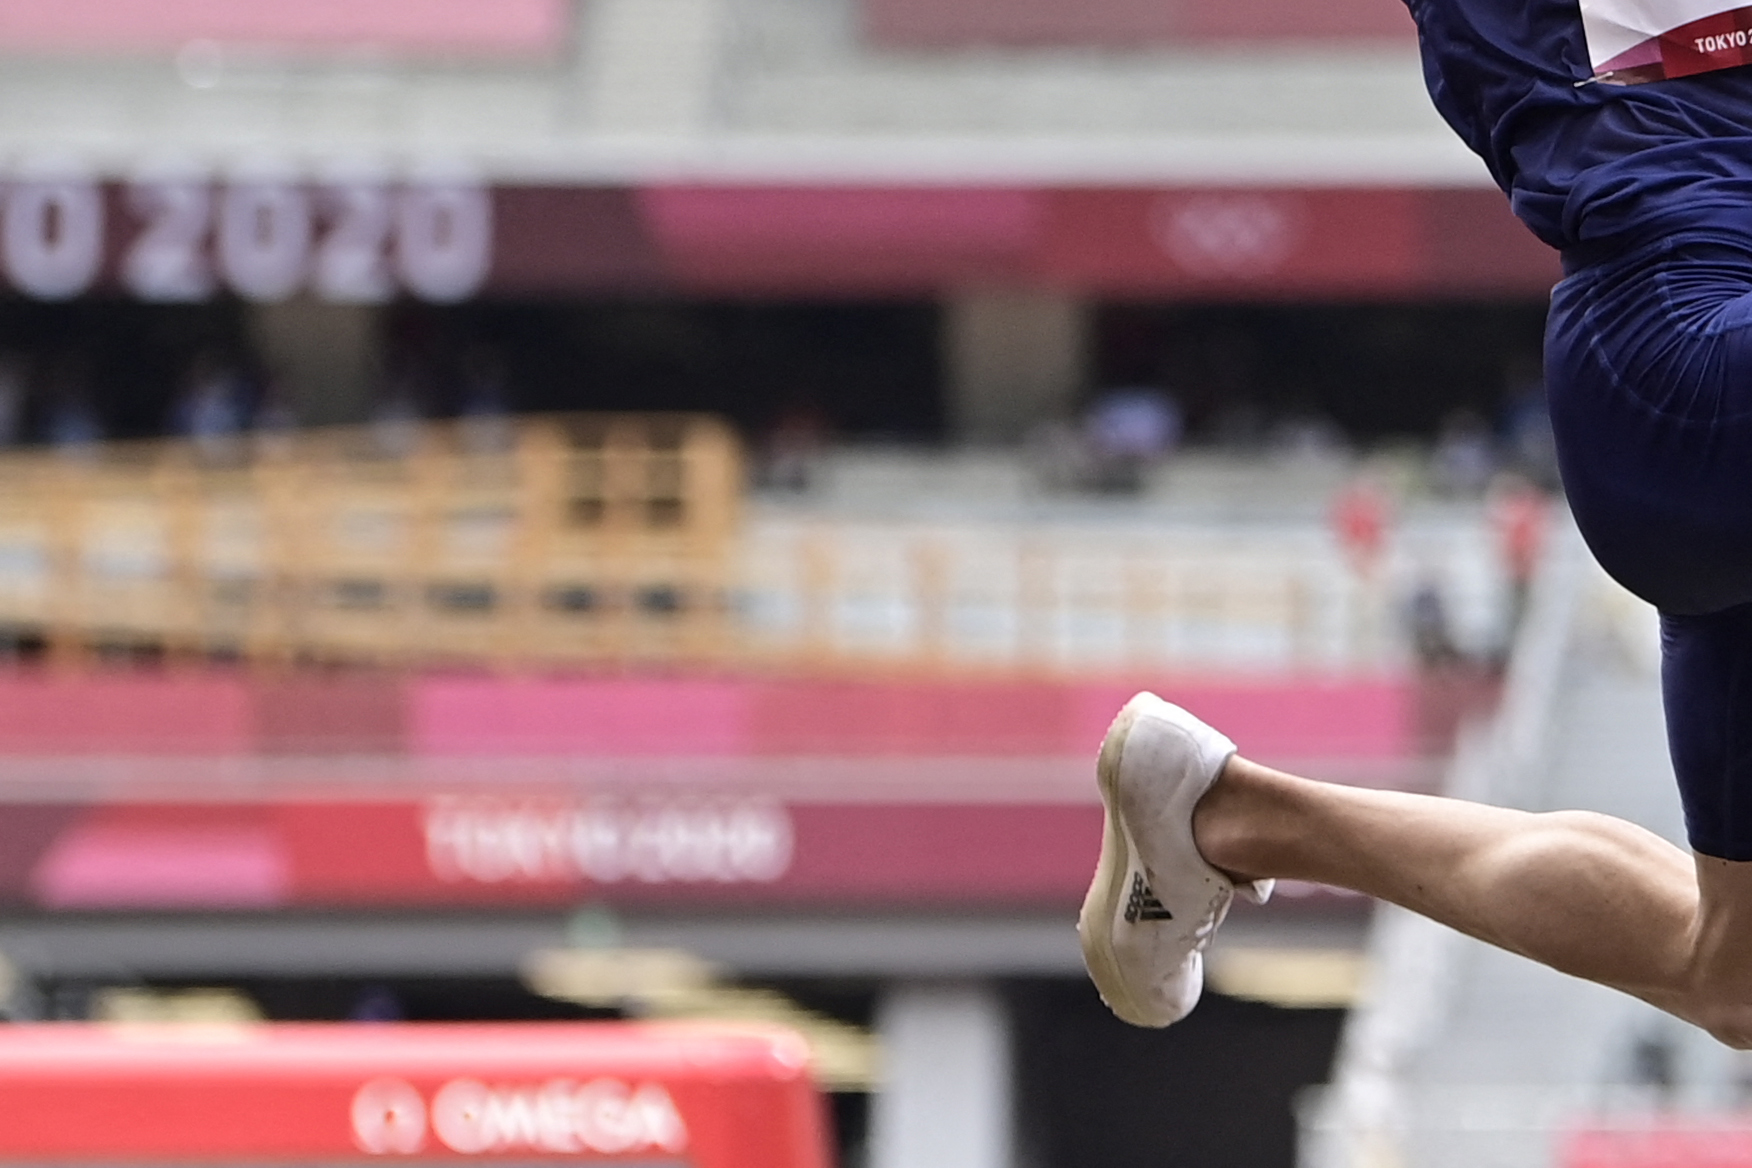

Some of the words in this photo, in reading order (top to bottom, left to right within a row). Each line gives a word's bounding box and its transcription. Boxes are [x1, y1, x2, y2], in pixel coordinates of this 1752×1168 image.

[1694, 30, 1747, 53] TOKYO
[117, 178, 493, 303] 2020
[430, 1078, 689, 1154] OMEGA
